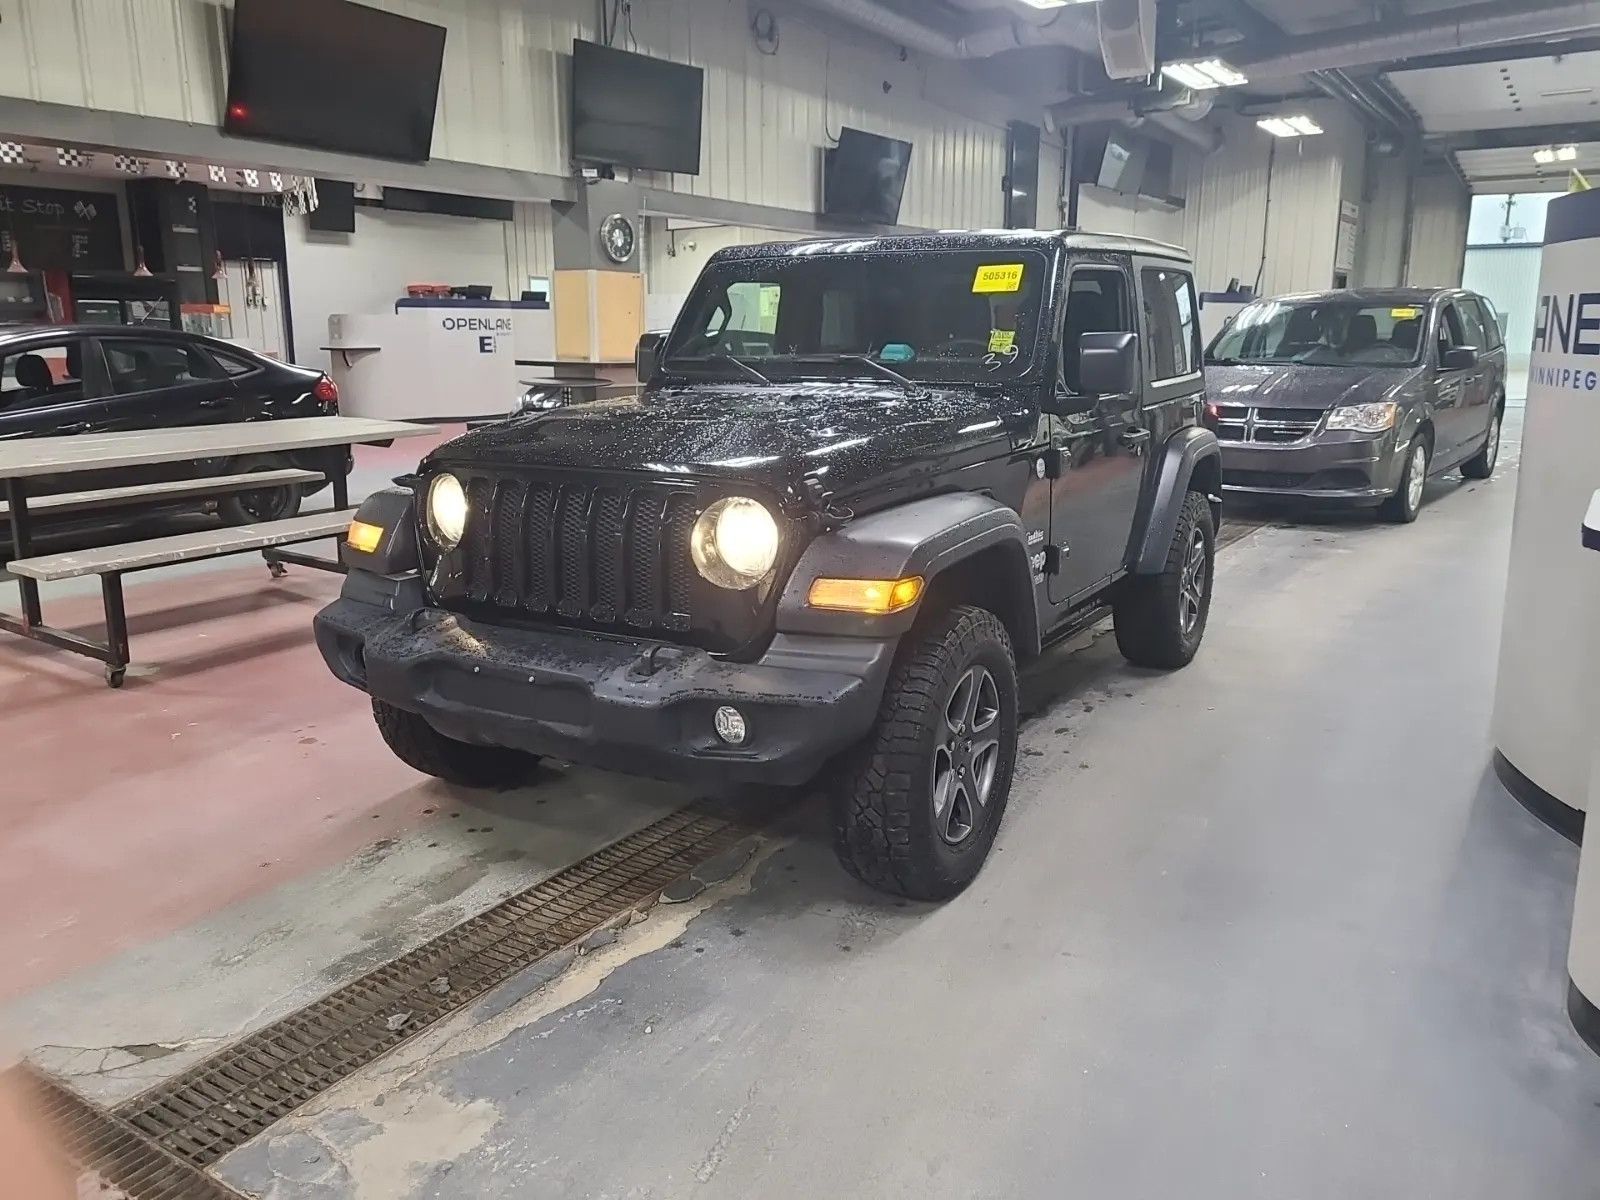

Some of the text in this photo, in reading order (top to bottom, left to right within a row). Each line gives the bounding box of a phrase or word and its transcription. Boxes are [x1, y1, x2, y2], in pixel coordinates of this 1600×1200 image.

[21, 199, 65, 221] Stop
[983, 271, 1018, 280] 505316
[442, 317, 512, 331] OPENLANE
